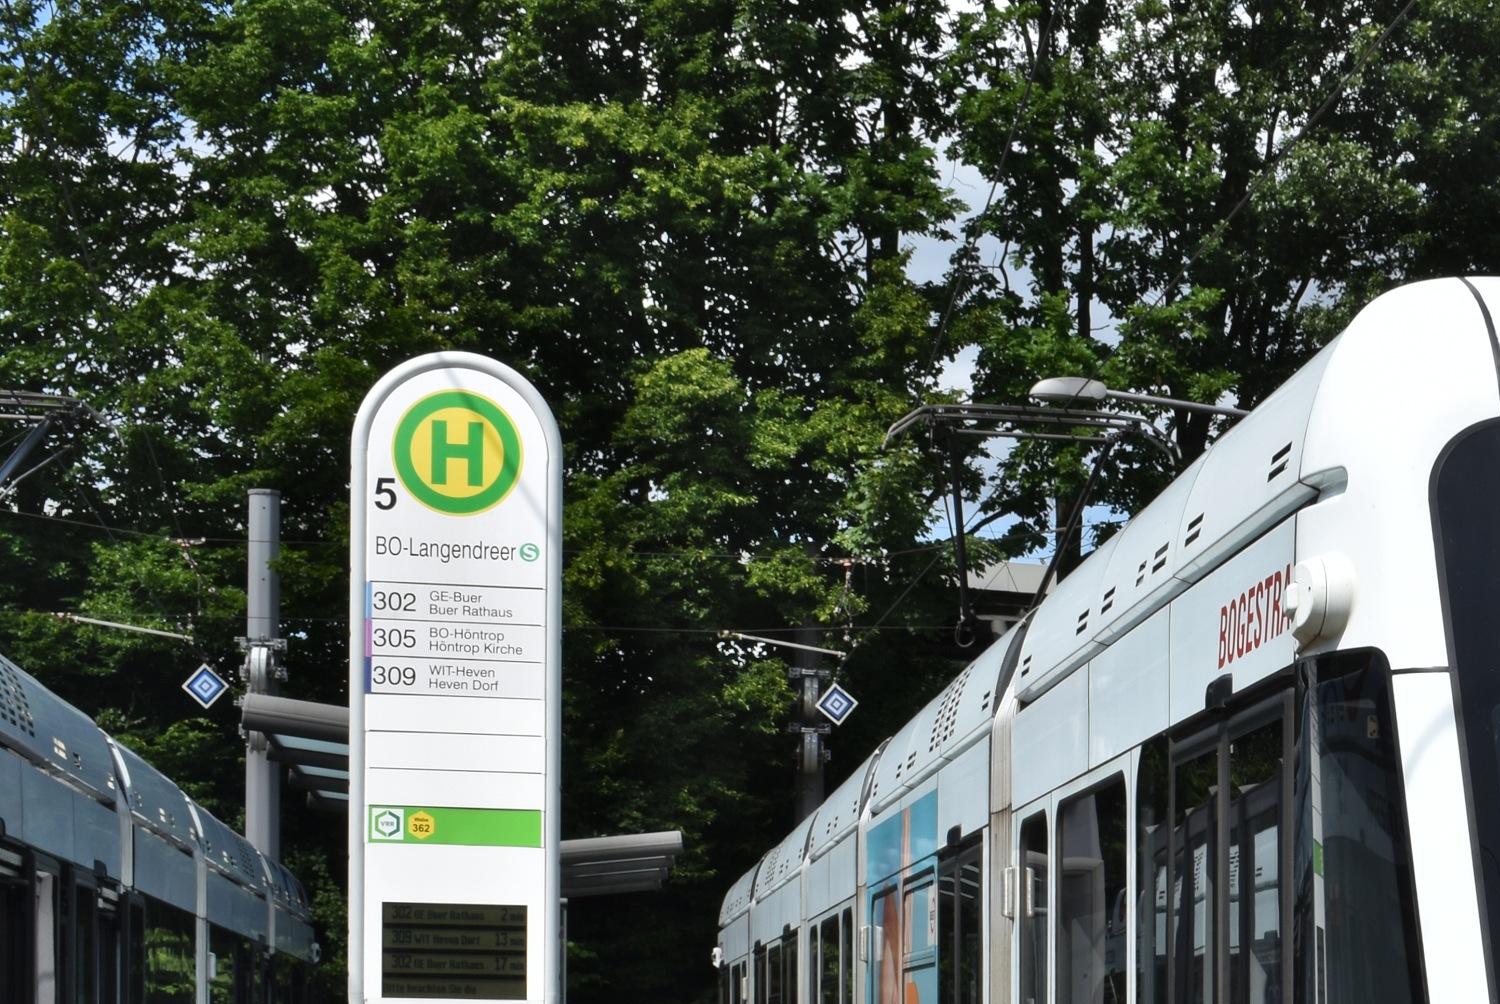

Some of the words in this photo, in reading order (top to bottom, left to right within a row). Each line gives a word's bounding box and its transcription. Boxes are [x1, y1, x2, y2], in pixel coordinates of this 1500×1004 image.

[431, 419, 484, 487] H
[374, 477, 397, 511] 5
[375, 536, 516, 563] BO-Langendreer
[373, 591, 416, 612] 302
[429, 590, 482, 603] GE-Buer
[429, 604, 459, 615] Buer
[462, 605, 513, 618] Rathaus
[373, 628, 416, 648] 305
[429, 627, 505, 643] BO-Höntrop
[429, 641, 480, 655] Höntrop
[484, 643, 523, 655] Kirche
[372, 665, 416, 686] 309
[429, 665, 495, 678] WIT-Heven
[429, 678, 468, 690] Heven
[472, 680, 499, 691] Dorf
[412, 823, 431, 833] 362
[501, 908, 508, 922] 2
[495, 932, 508, 946] 13
[495, 957, 508, 971] 17
